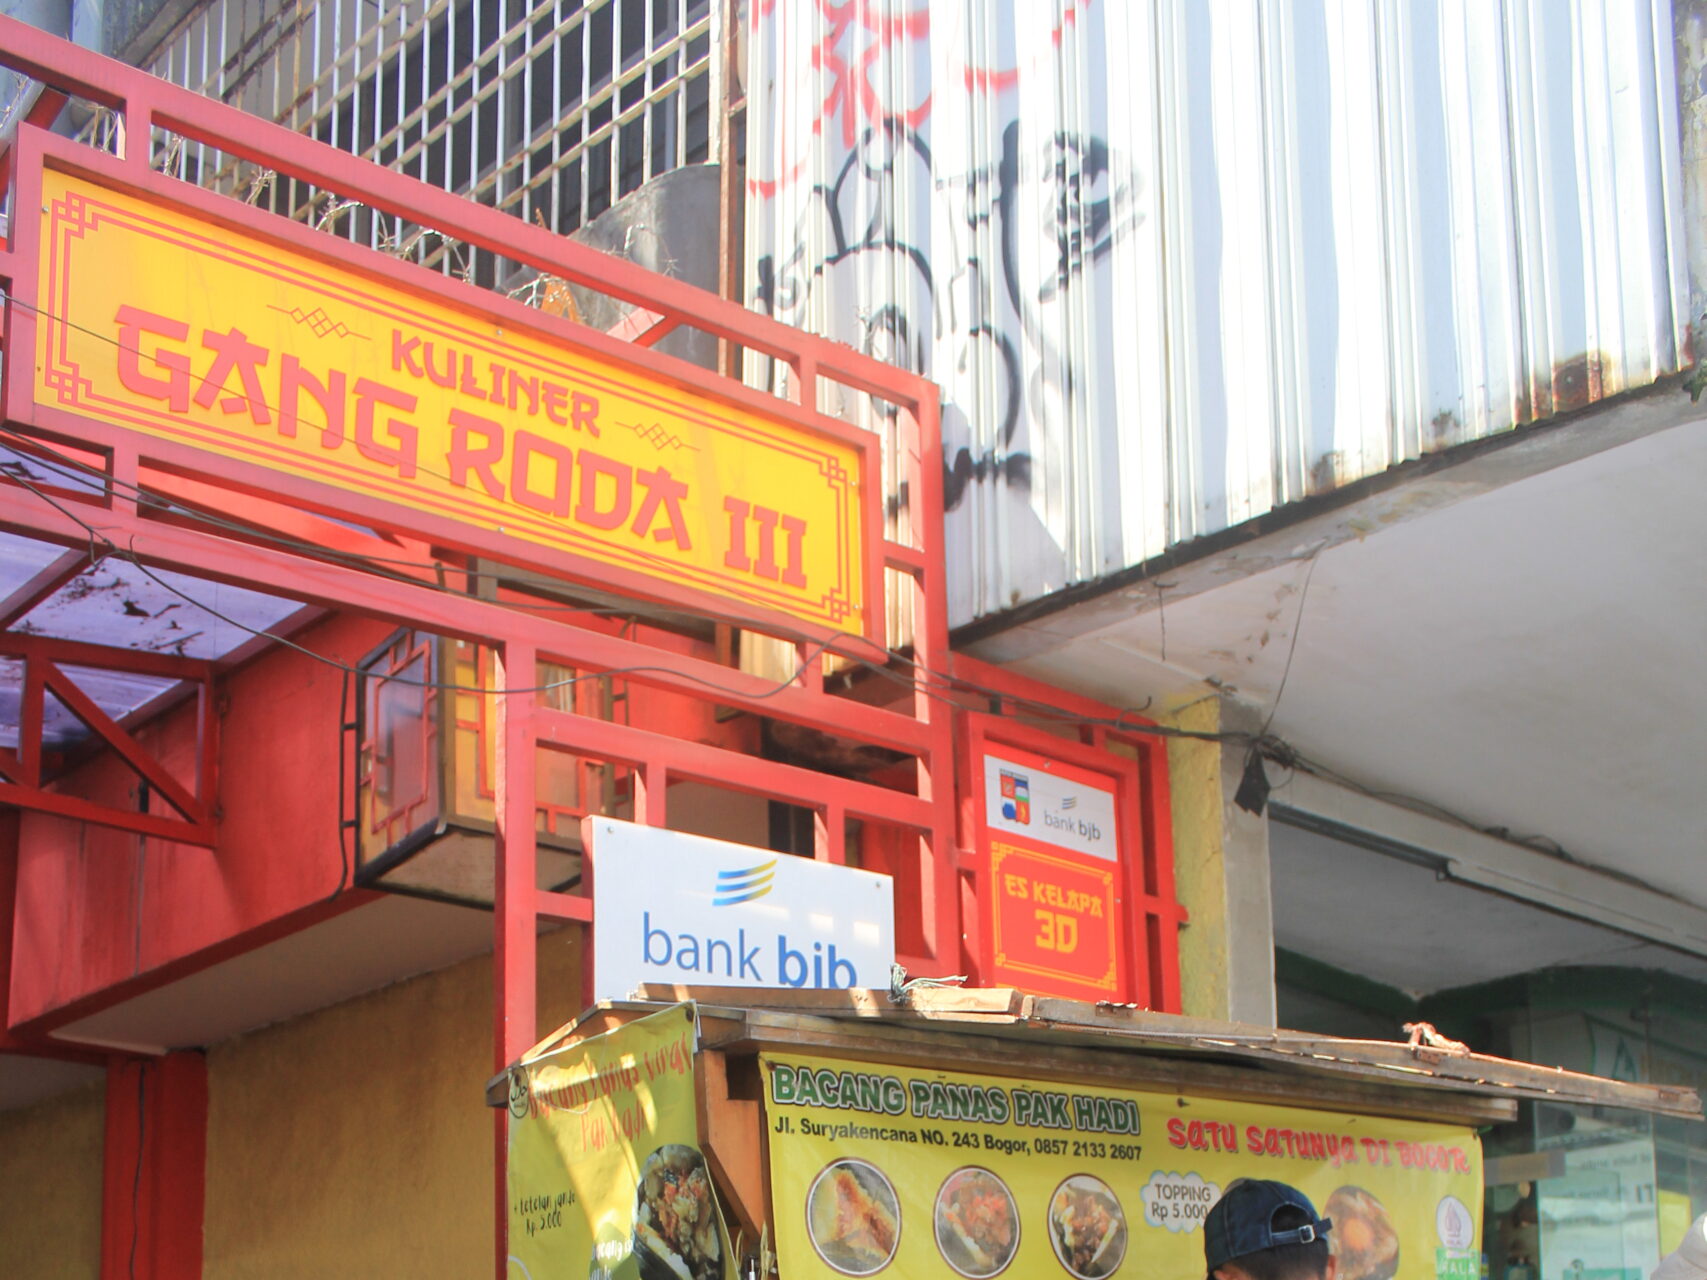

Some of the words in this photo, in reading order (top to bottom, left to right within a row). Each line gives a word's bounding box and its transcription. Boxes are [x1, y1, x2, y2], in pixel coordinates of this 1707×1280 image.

[391, 329, 600, 438] KULINER
[115, 304, 423, 479] GANG
[446, 408, 693, 551] RODA
[724, 496, 808, 590] III
[1044, 810, 1075, 833] bank
[1079, 821, 1101, 841] bjb
[1004, 873, 1028, 898] ES
[1033, 881, 1103, 918] KELAPA
[643, 911, 763, 982] bank
[1035, 908, 1079, 954] 3D
[770, 1063, 907, 1115] BACANG
[909, 1078, 1010, 1125] PANAS
[1011, 1088, 1072, 1130] PAK
[1072, 1094, 1141, 1136] HADI
[775, 1116, 795, 1134] Jl.
[800, 1118, 917, 1142] Suryakencana
[921, 1128, 948, 1146] NO.
[952, 1131, 979, 1149] 243
[984, 1134, 1031, 1156] Bogor,
[1034, 1138, 1068, 1155] 0857
[1073, 1141, 1106, 1158] 2133
[1110, 1144, 1141, 1161] 2607
[1360, 1137, 1393, 1166] DI
[1151, 1201, 1168, 1222] Rp
[1154, 1183, 1211, 1202] TOPPING
